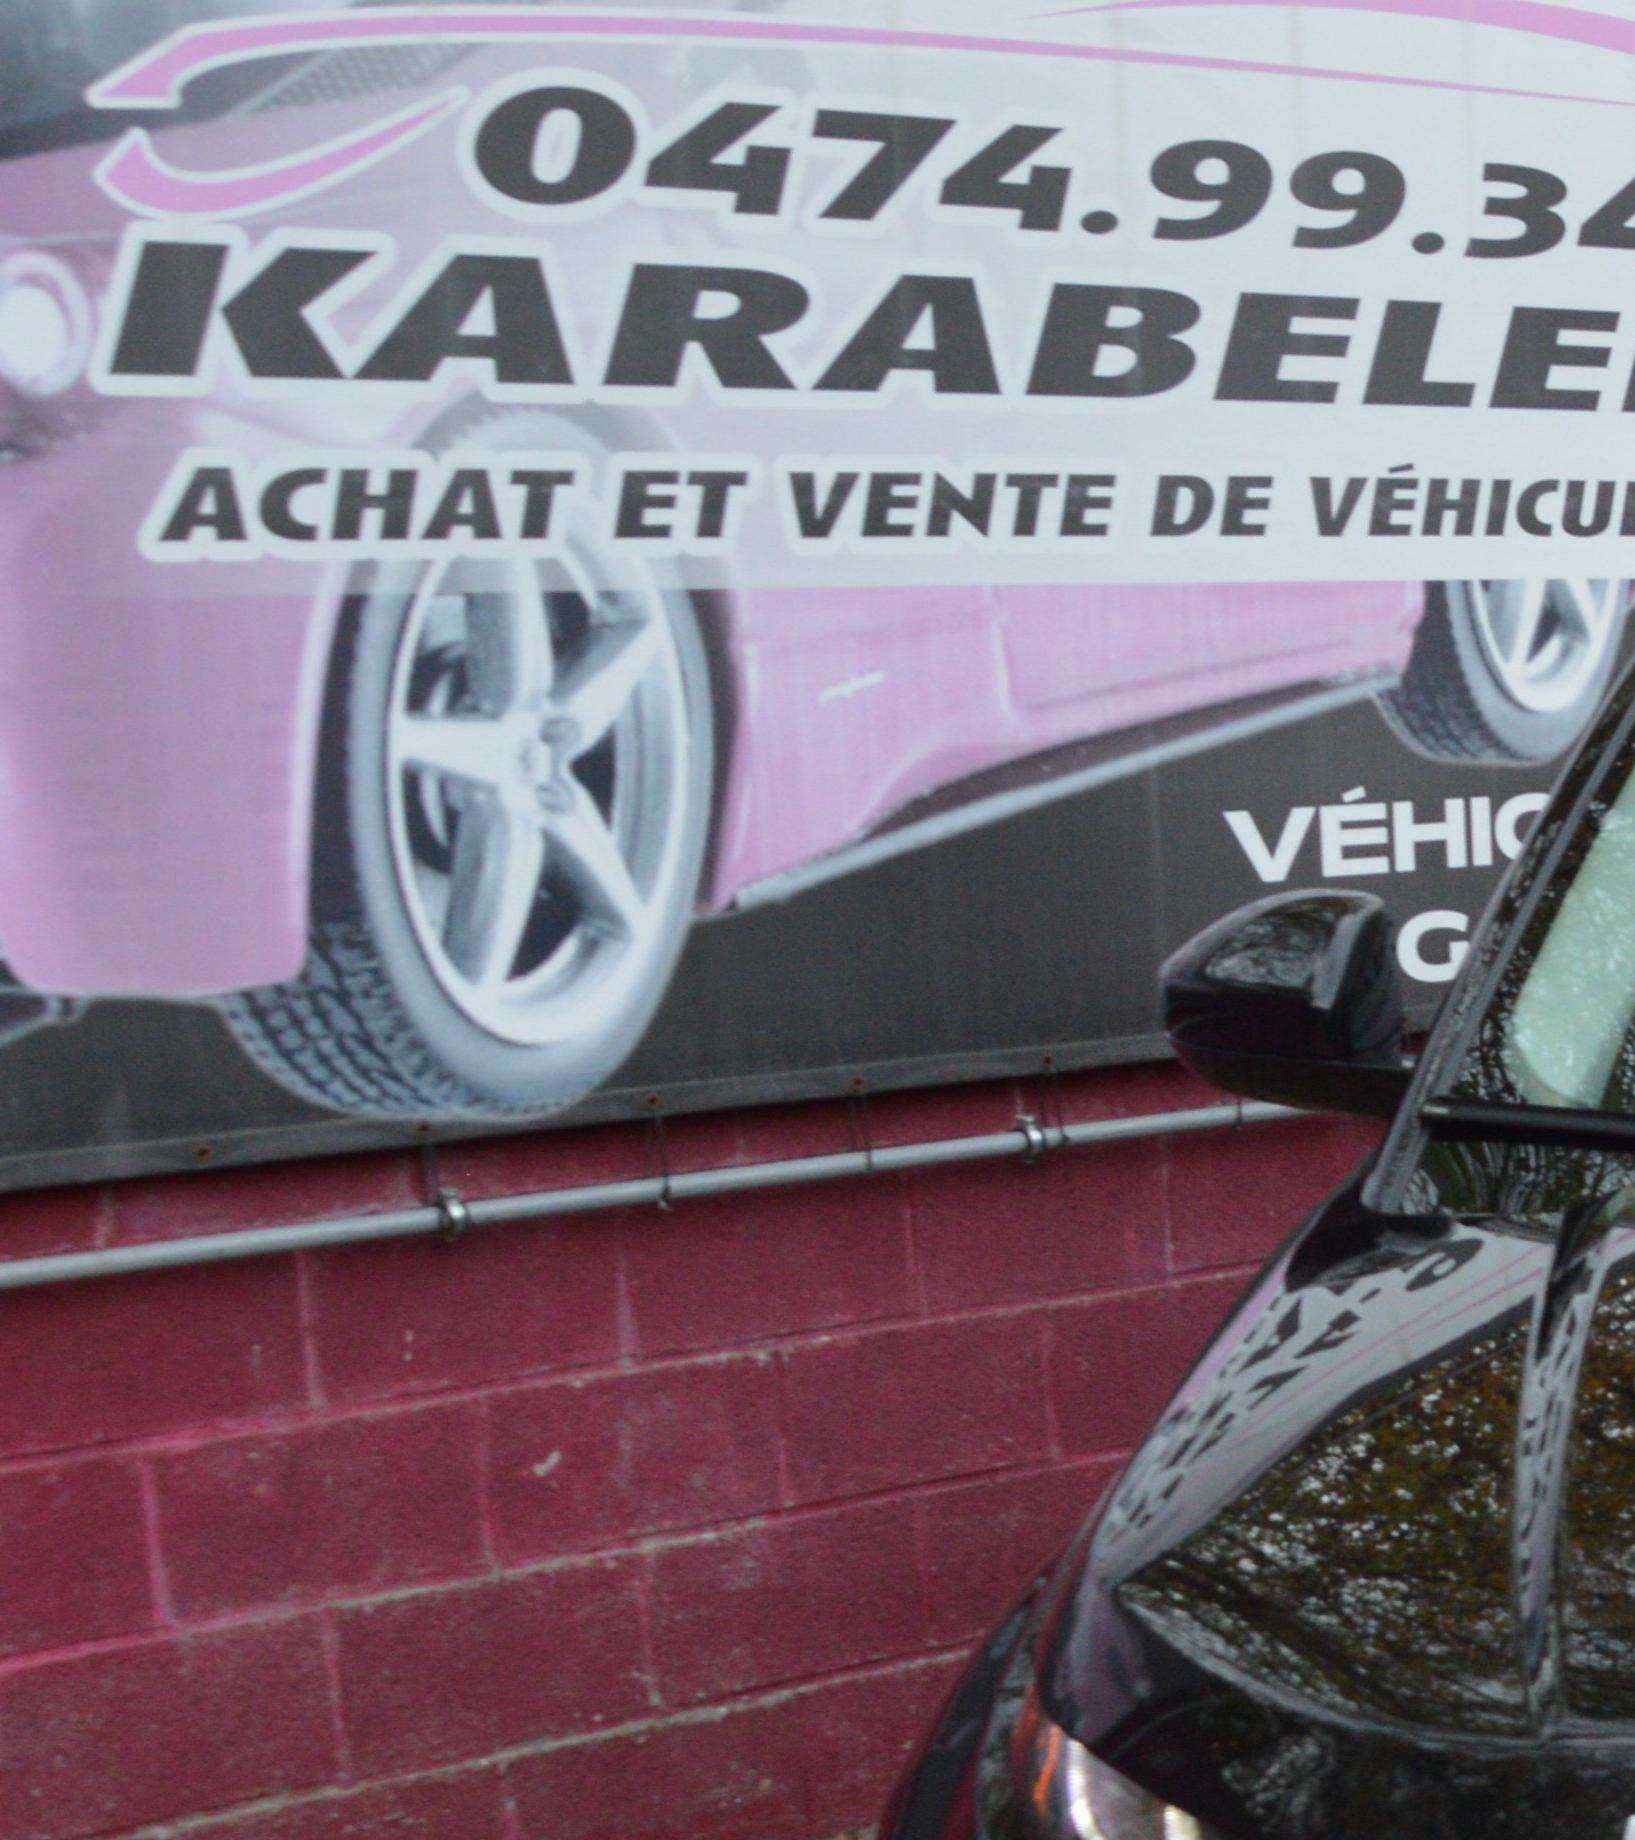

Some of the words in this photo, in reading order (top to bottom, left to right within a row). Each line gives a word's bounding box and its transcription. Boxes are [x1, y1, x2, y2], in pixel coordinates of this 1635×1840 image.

[160, 466, 574, 541] ACHAT
[614, 470, 748, 539] ET
[788, 471, 1116, 539] VENTE
[1150, 474, 1273, 537] DE
